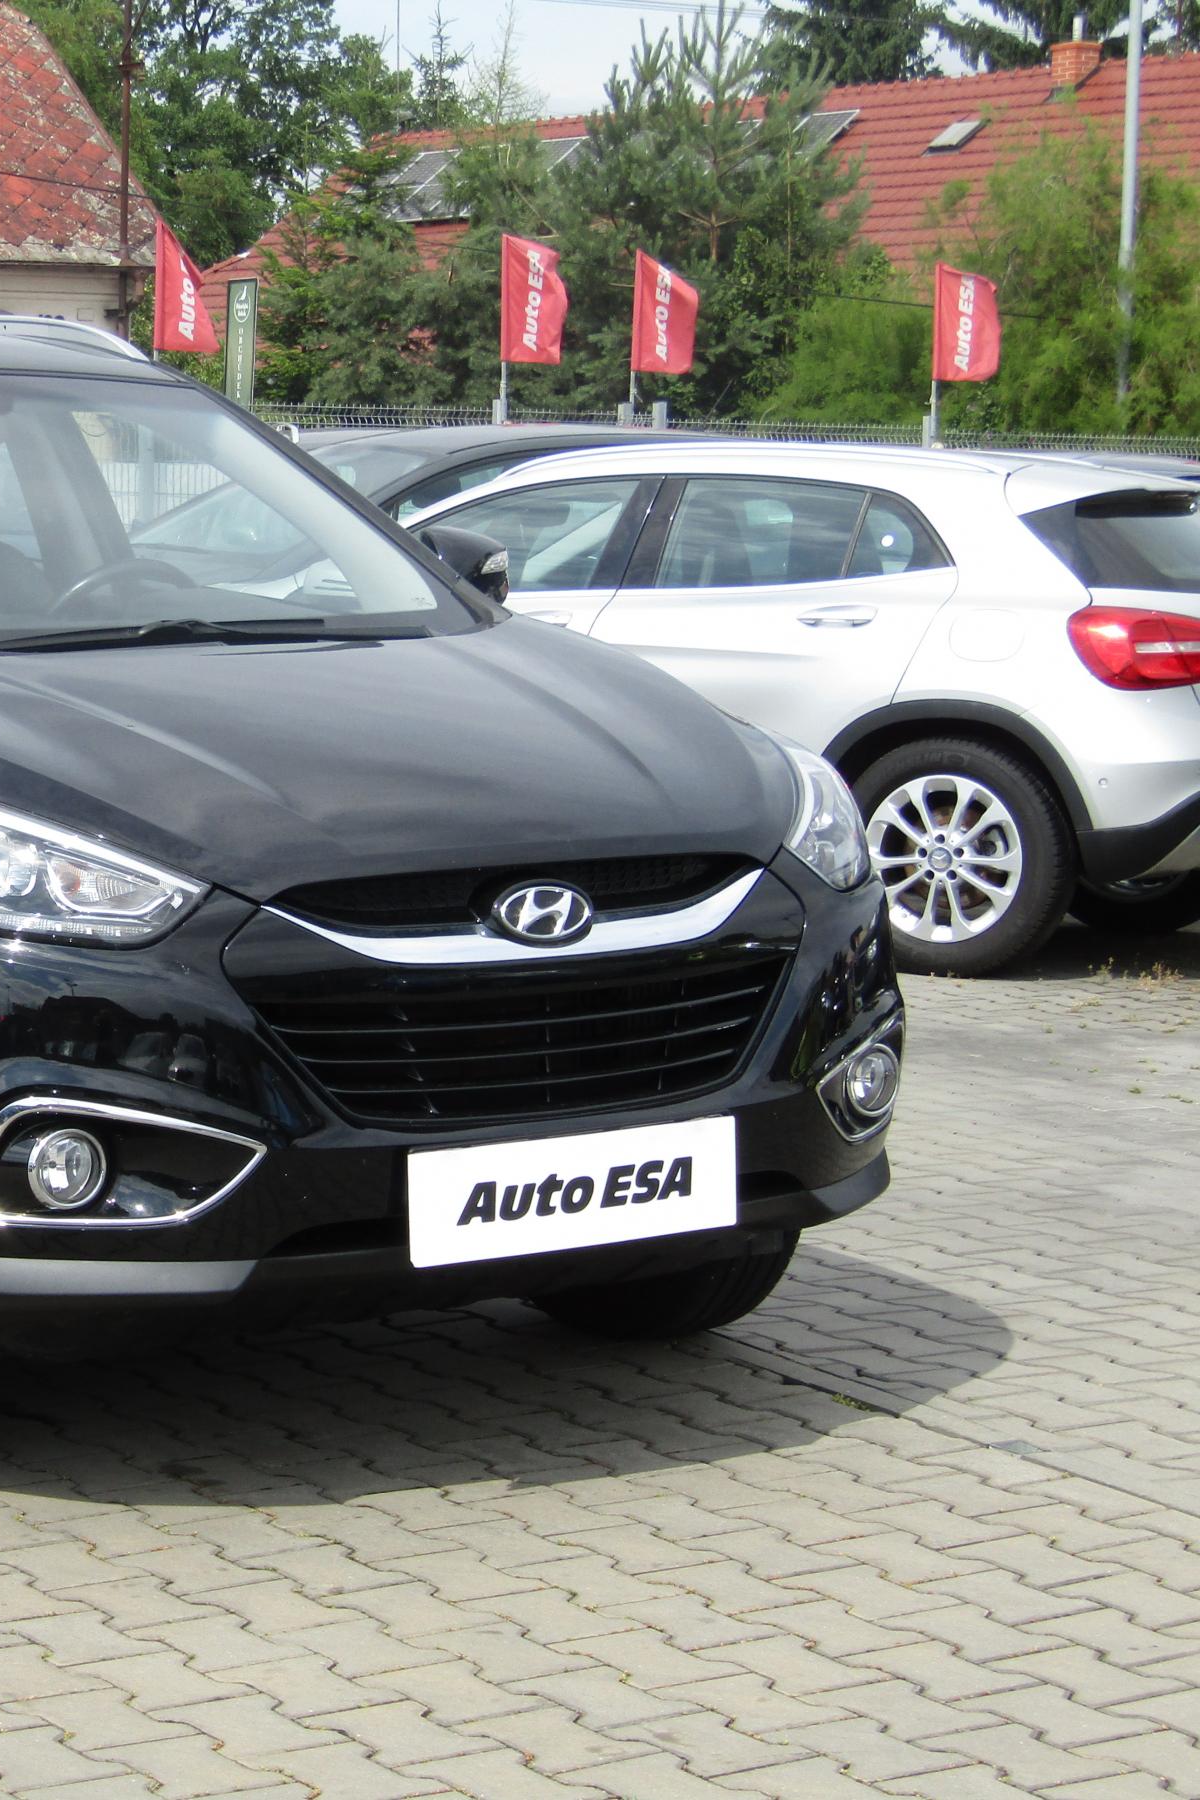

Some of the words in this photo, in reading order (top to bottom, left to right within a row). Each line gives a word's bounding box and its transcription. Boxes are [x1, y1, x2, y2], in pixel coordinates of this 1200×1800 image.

[178, 278, 196, 342] Auto
[522, 290, 542, 352] Auto
[958, 274, 976, 315] ESA
[655, 305, 669, 362] Auto
[953, 316, 973, 374] Auto
[456, 1173, 595, 1227] Auto
[599, 1155, 693, 1209] ESA
